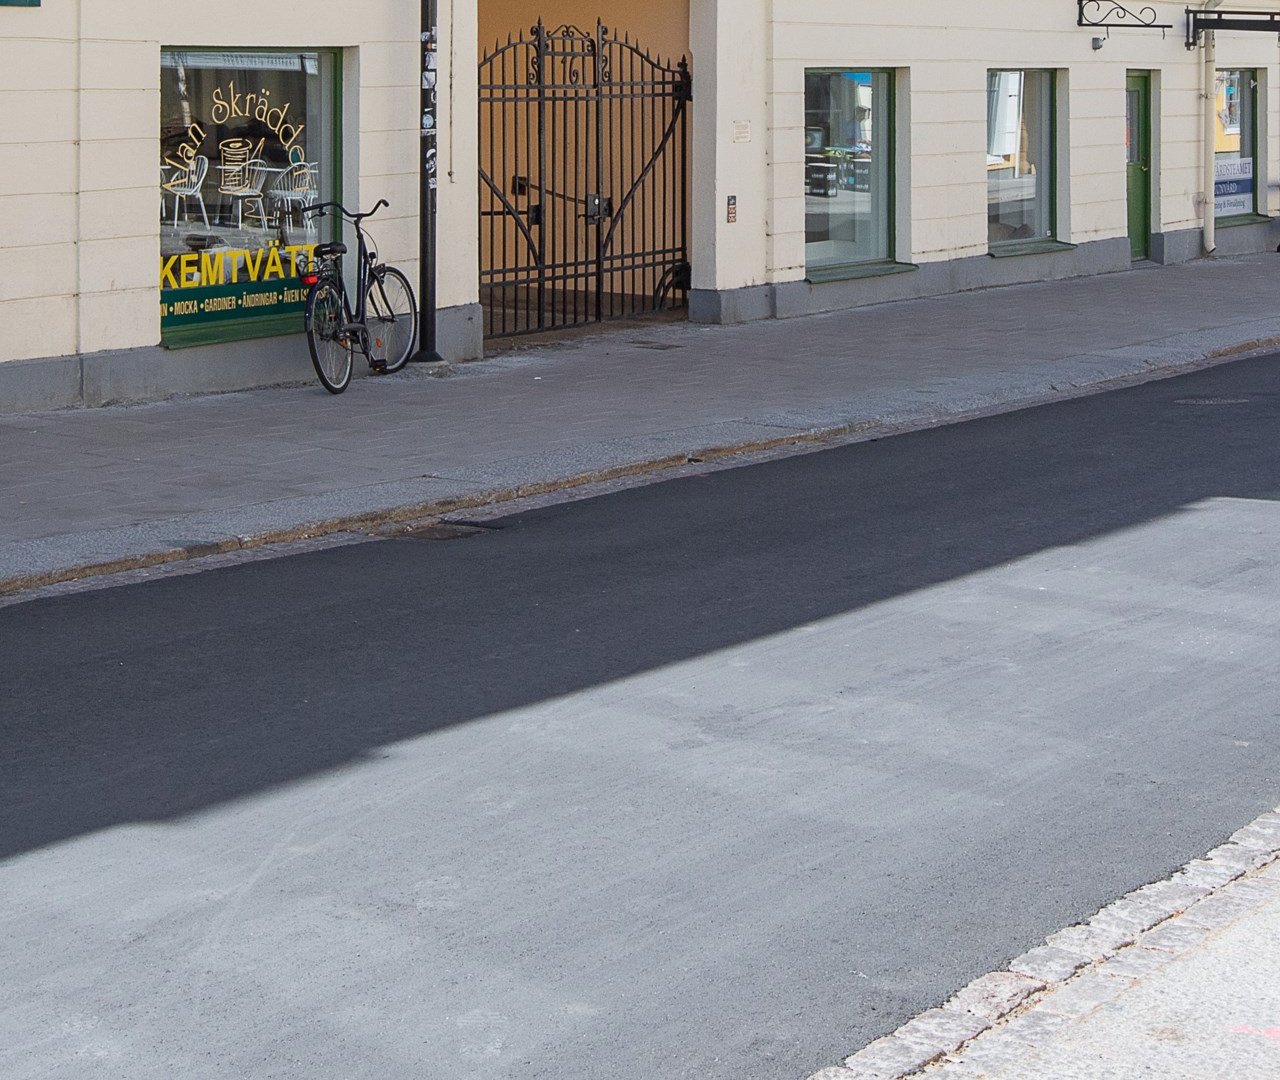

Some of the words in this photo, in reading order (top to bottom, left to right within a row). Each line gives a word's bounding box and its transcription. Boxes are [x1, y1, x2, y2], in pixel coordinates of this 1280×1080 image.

[162, 122, 207, 200] Alan
[212, 80, 317, 192] Skrädderi
[174, 300, 198, 316] MOCKA
[204, 296, 236, 312] GARDINER
[242, 292, 277, 308] ÄNDRINGAR
[284, 287, 298, 303] ÄVEN
